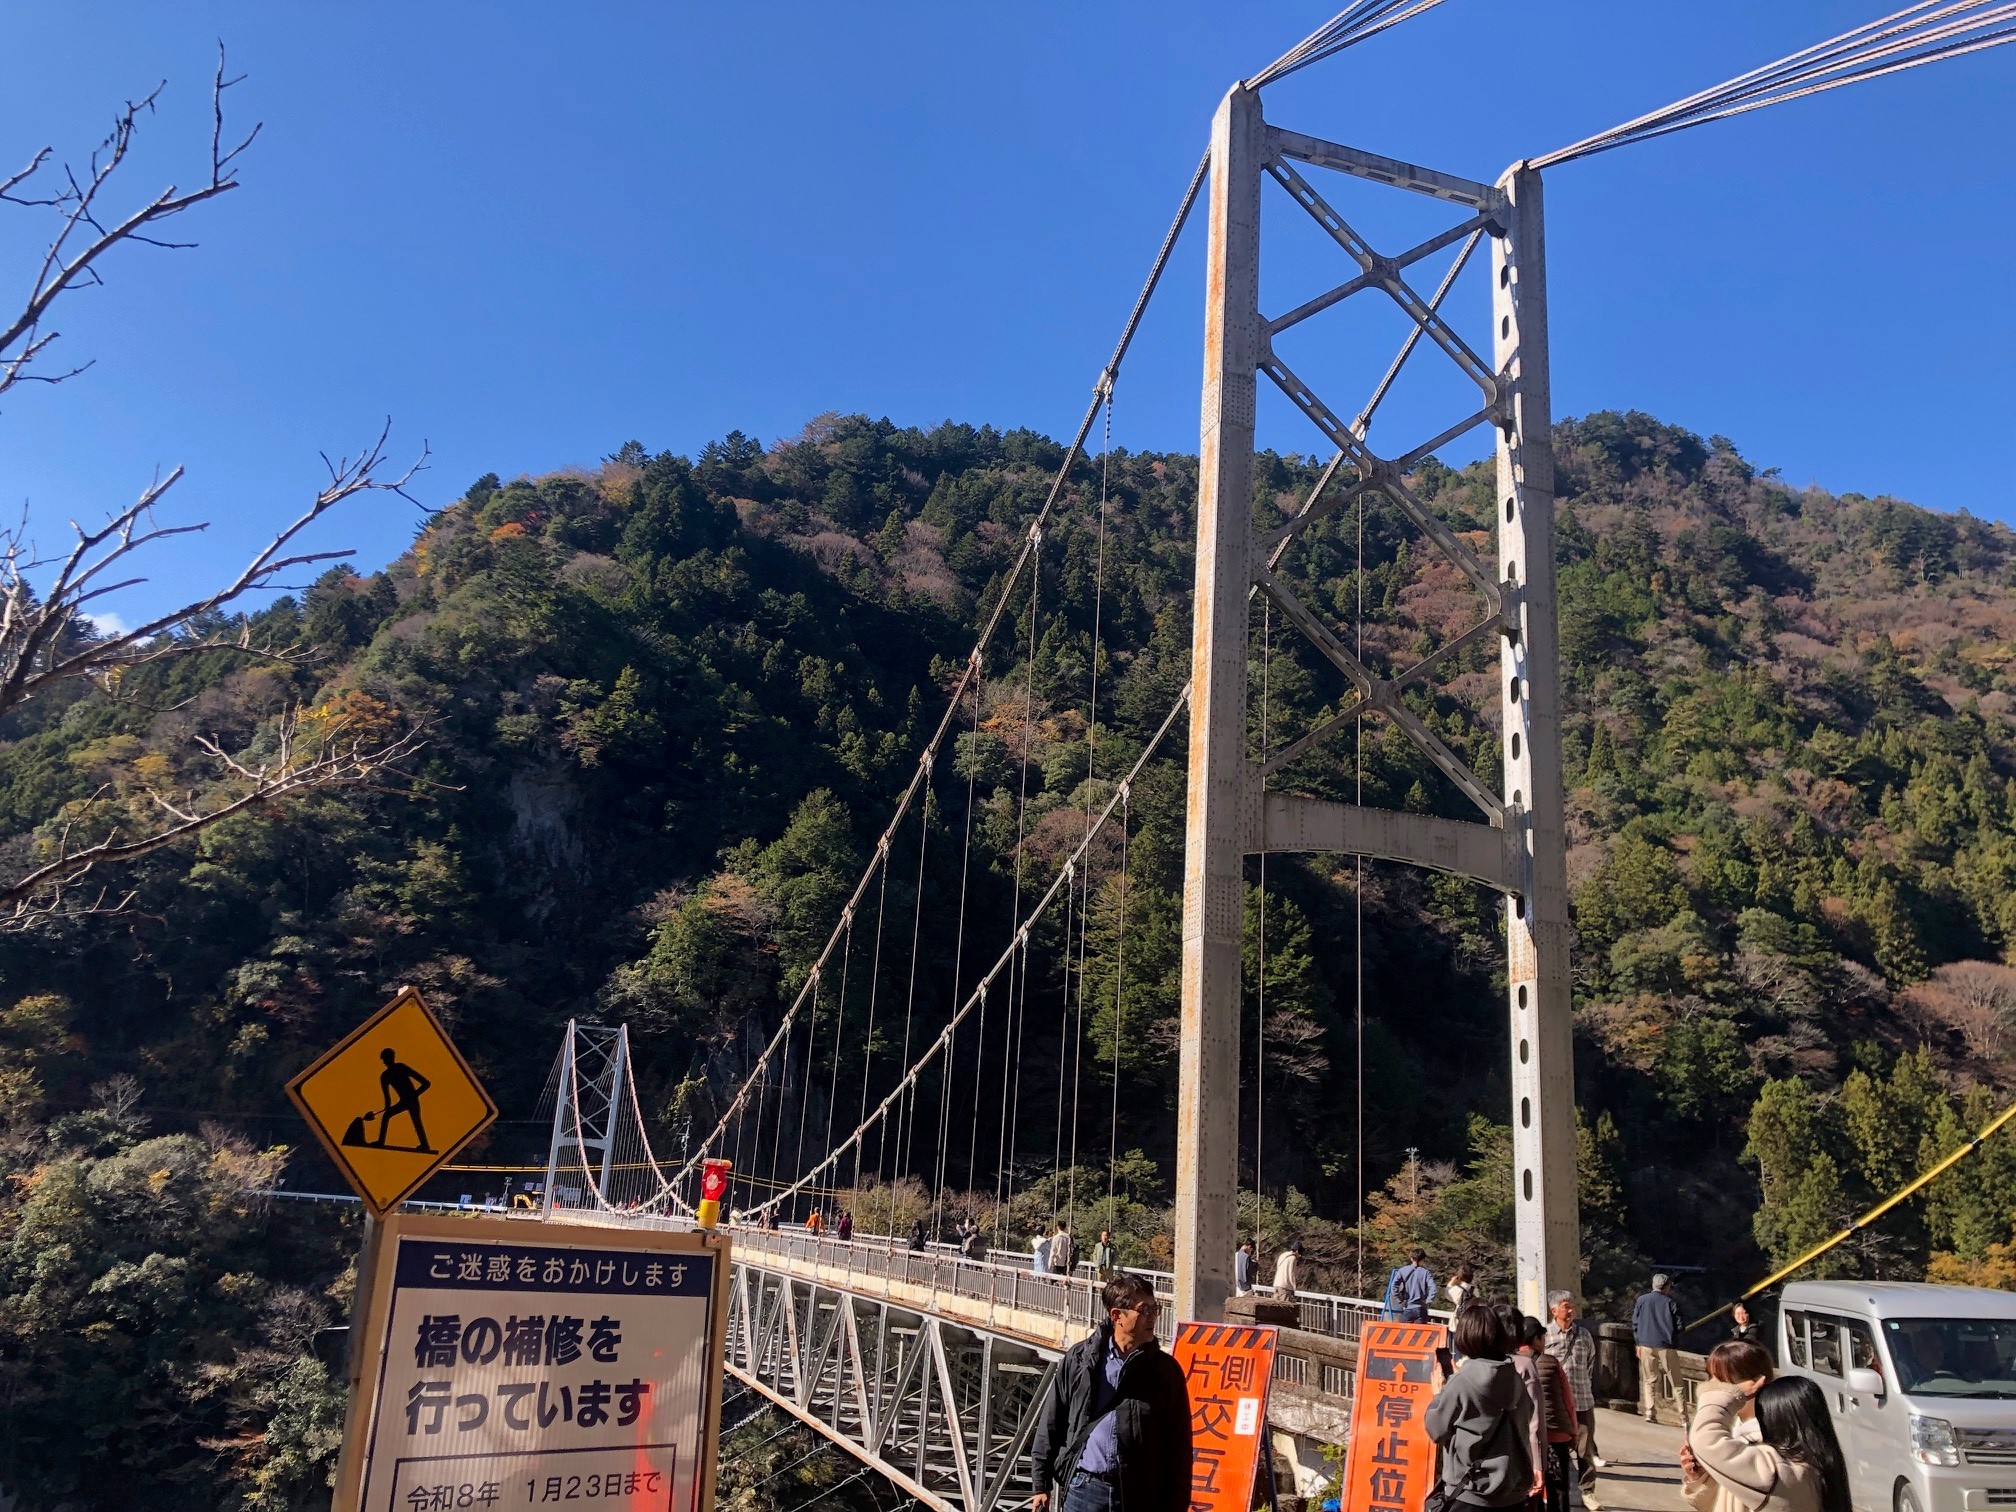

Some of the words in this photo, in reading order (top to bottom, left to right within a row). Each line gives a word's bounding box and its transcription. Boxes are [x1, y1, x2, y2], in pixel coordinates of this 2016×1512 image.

[430, 1253, 689, 1287] ご迷惑をおかけします
[414, 1314, 623, 1369] 橋の補修を
[1186, 1352, 1256, 1392] 片側
[1378, 1382, 1419, 1394] STOP
[406, 1378, 650, 1436] 行っています
[1191, 1394, 1234, 1512] 交互
[1369, 1394, 1414, 1512] 停止位
[407, 1480, 500, 1512] 令和8年
[527, 1471, 660, 1502] 1月23日まで
